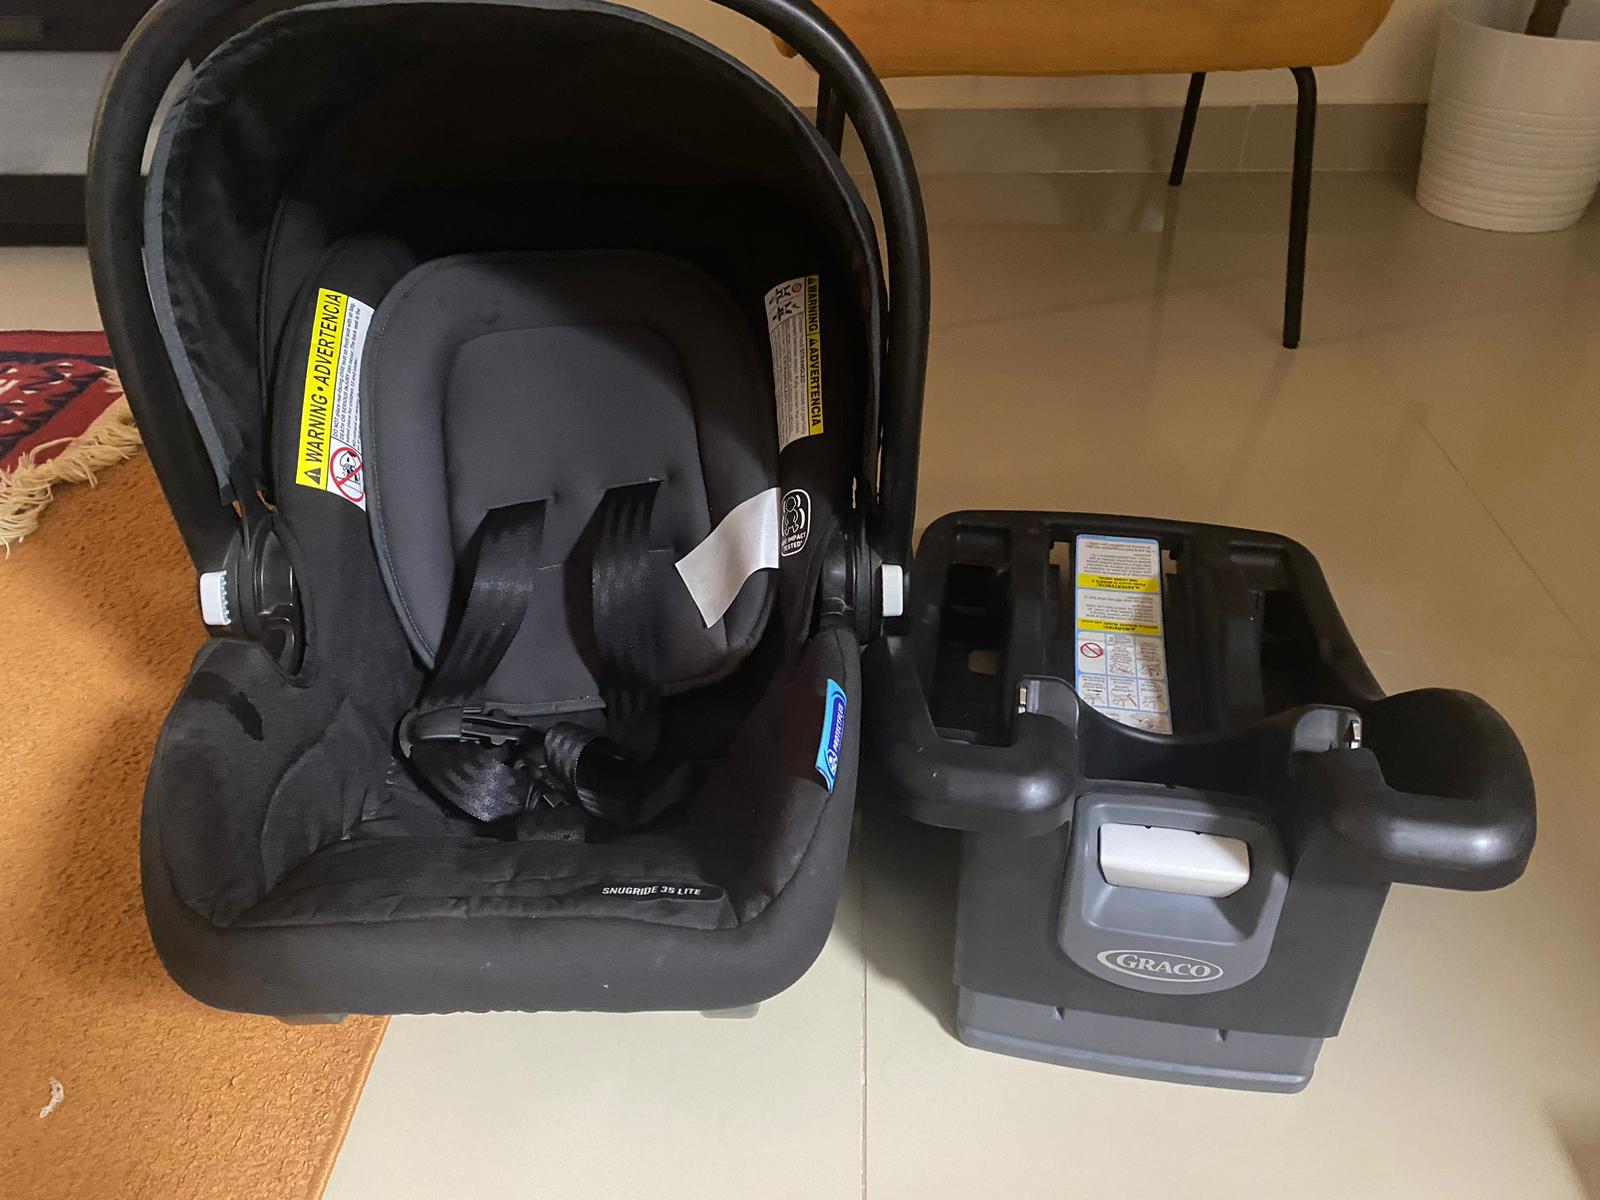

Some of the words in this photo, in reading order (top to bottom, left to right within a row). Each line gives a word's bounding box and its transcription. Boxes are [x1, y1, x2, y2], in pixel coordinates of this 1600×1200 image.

[808, 286, 818, 331] WARNING
[314, 293, 342, 386] ADVERTENCIA
[810, 348, 821, 426] ADVERTENCIA
[305, 394, 327, 462] WARNING
[833, 703, 844, 752] PROTECTPLUS
[602, 886, 659, 896] SNUGRIDE
[660, 886, 675, 894] 35
[677, 887, 701, 896] LITE
[1117, 954, 1211, 977] GRACO
